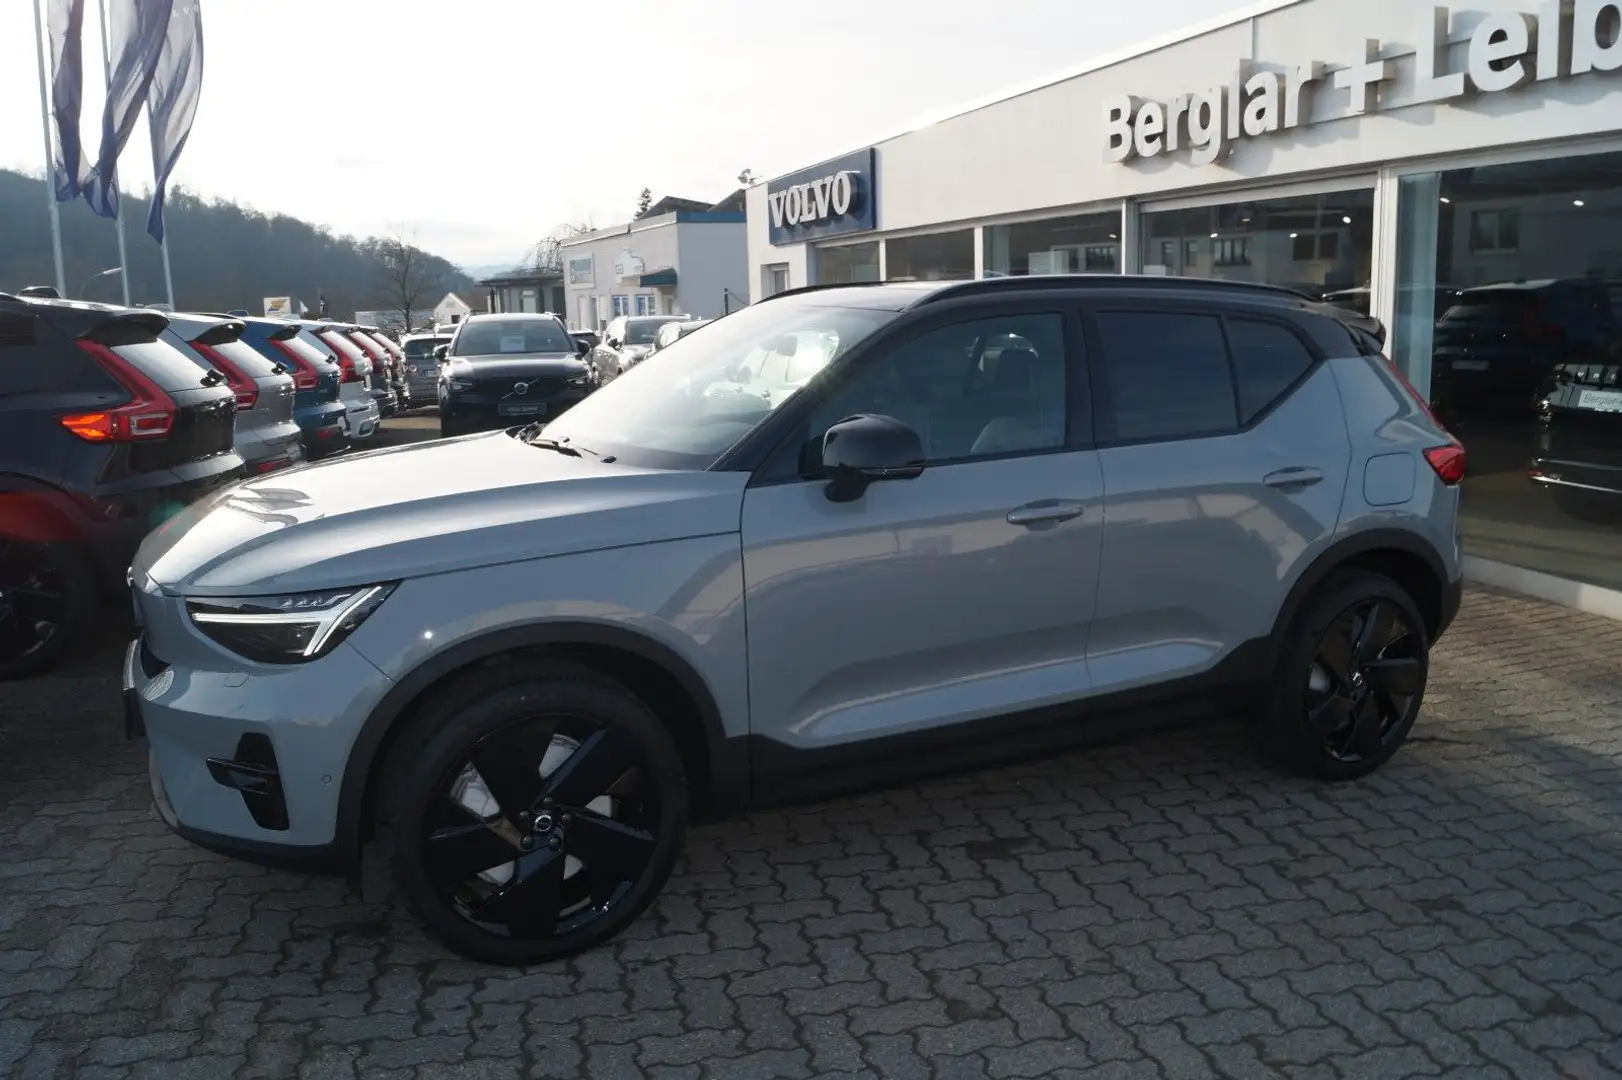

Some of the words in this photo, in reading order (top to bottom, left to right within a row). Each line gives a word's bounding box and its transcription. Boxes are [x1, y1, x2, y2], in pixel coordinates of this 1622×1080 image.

[1102, 58, 1316, 167] Berglar
[1334, 38, 1385, 113] +
[769, 171, 851, 228] VOLVO
